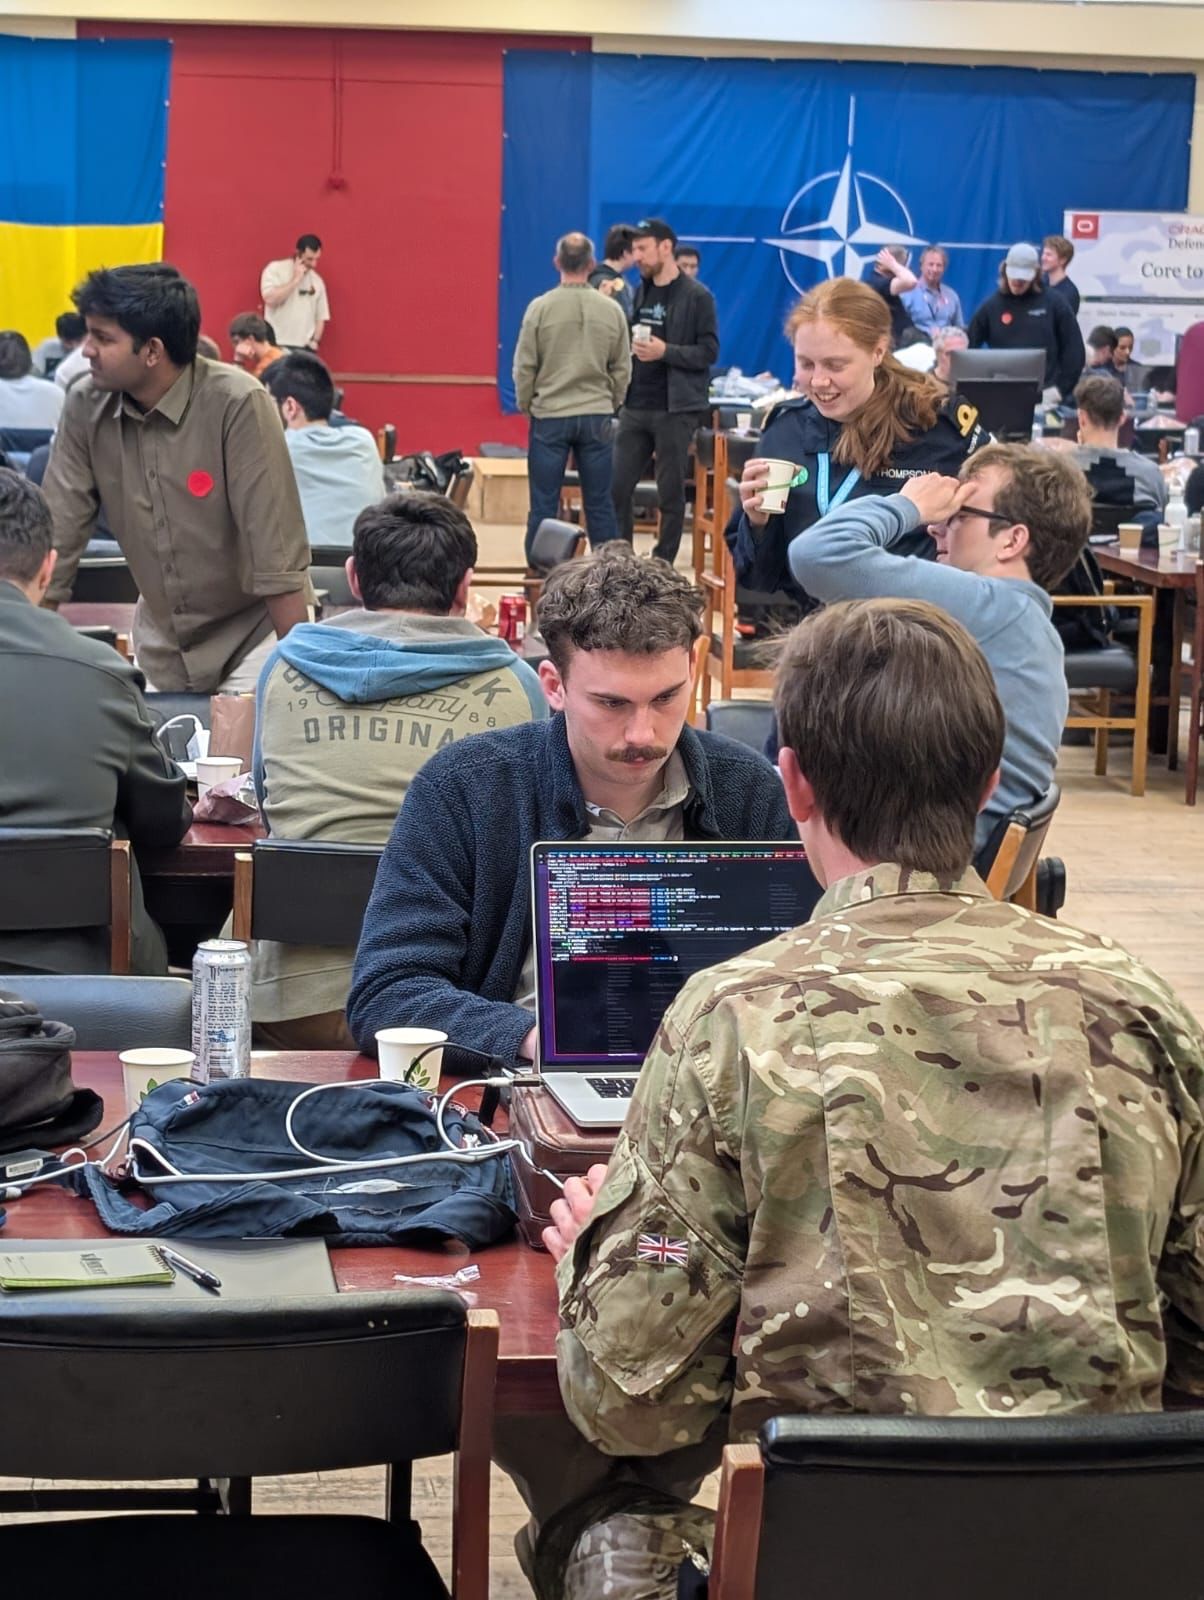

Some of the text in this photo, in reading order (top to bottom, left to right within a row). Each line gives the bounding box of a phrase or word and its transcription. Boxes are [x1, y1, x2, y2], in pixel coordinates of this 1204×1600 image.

[1168, 237, 1204, 249] Defen
[1141, 262, 1203, 279] Core to
[876, 469, 930, 480] HOMPSO
[303, 714, 471, 750] ORIGINA
